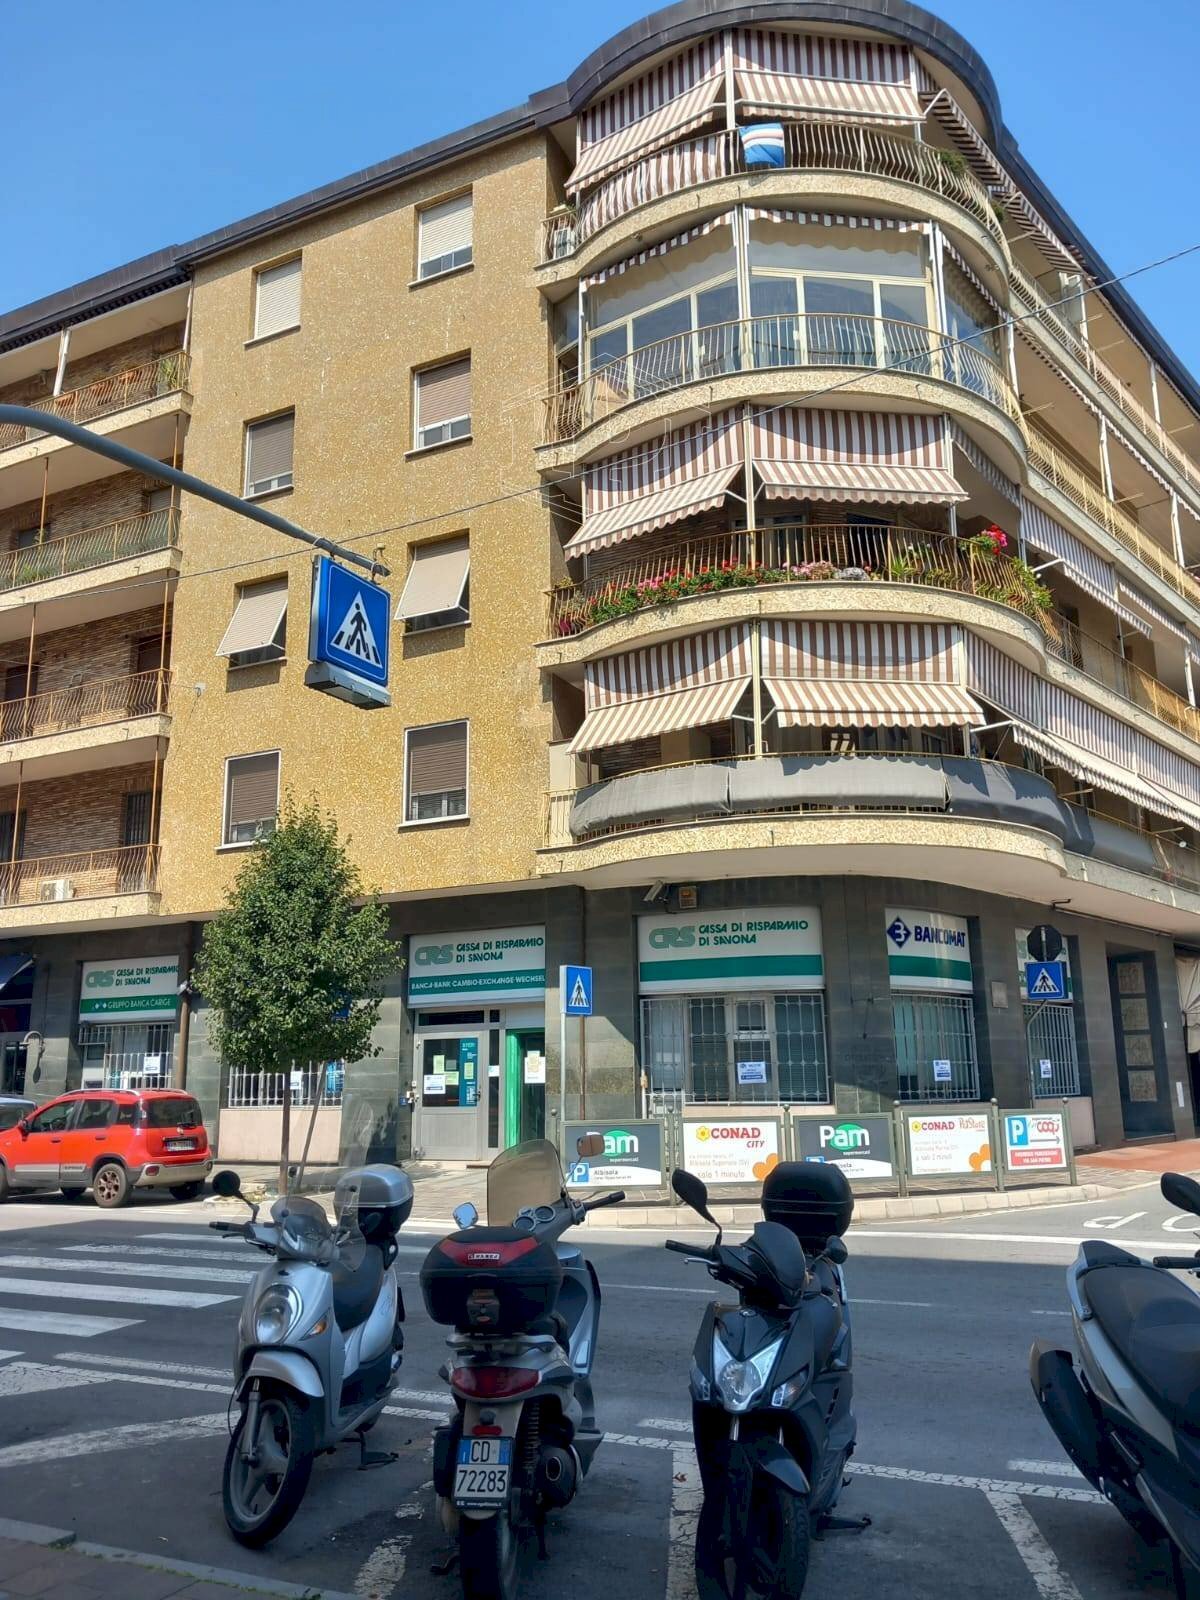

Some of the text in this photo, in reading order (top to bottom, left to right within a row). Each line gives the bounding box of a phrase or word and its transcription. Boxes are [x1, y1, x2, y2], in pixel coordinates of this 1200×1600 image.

[698, 919, 809, 935] CASSA DI RISPARMIO
[698, 933, 757, 947] DI SAVONA
[914, 925, 966, 948] BANCOMAT
[456, 938, 544, 952] CASSA DI RISPARMIO
[456, 952, 503, 963] DI SAVONA
[117, 968, 135, 977] CASSA
[125, 977, 151, 986] SAVONA
[710, 1126, 762, 1139] CONAD
[921, 1121, 956, 1131] CONAD
[586, 1131, 639, 1154] am
[819, 1125, 870, 1148] Pam
[746, 1140, 765, 1149] CITY
[574, 1165, 586, 1182] P
[720, 1169, 745, 1178] minuto
[471, 1441, 490, 1462] CD
[457, 1469, 507, 1493] 72283
